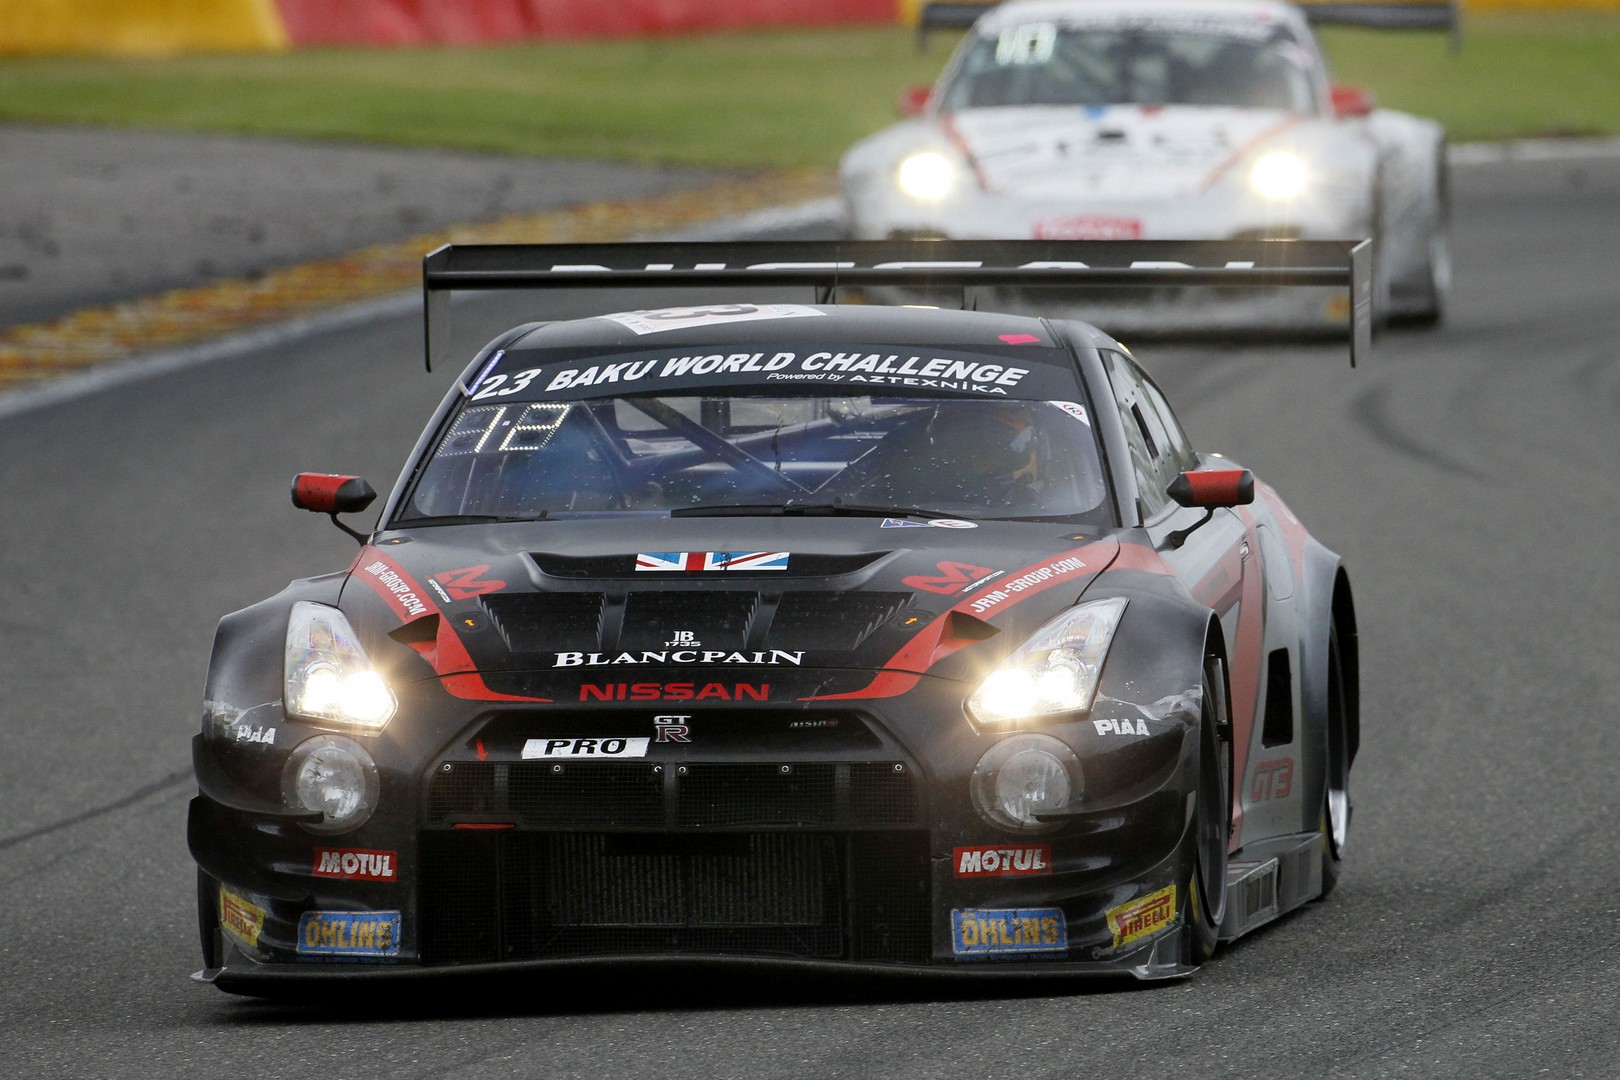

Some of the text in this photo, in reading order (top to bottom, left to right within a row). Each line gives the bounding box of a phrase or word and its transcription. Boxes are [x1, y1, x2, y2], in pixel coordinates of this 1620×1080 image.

[471, 352, 1030, 401] 23 BAKU WORLD CHALLENGE
[766, 372, 824, 381] Powered
[826, 373, 845, 382] by
[970, 556, 1087, 613] JRM-GROUP.COM
[551, 649, 806, 668] BLANCPAIN
[579, 683, 770, 701] NISSAN
[654, 725, 692, 743] R
[1092, 718, 1150, 736] PIAA
[543, 739, 628, 755] PRO
[1251, 756, 1295, 802] GT3
[318, 850, 394, 877] MOTUL
[958, 849, 1047, 873] MOTUL
[1114, 894, 1172, 938] PIRELLI
[960, 912, 1059, 947] ÖHLINS
